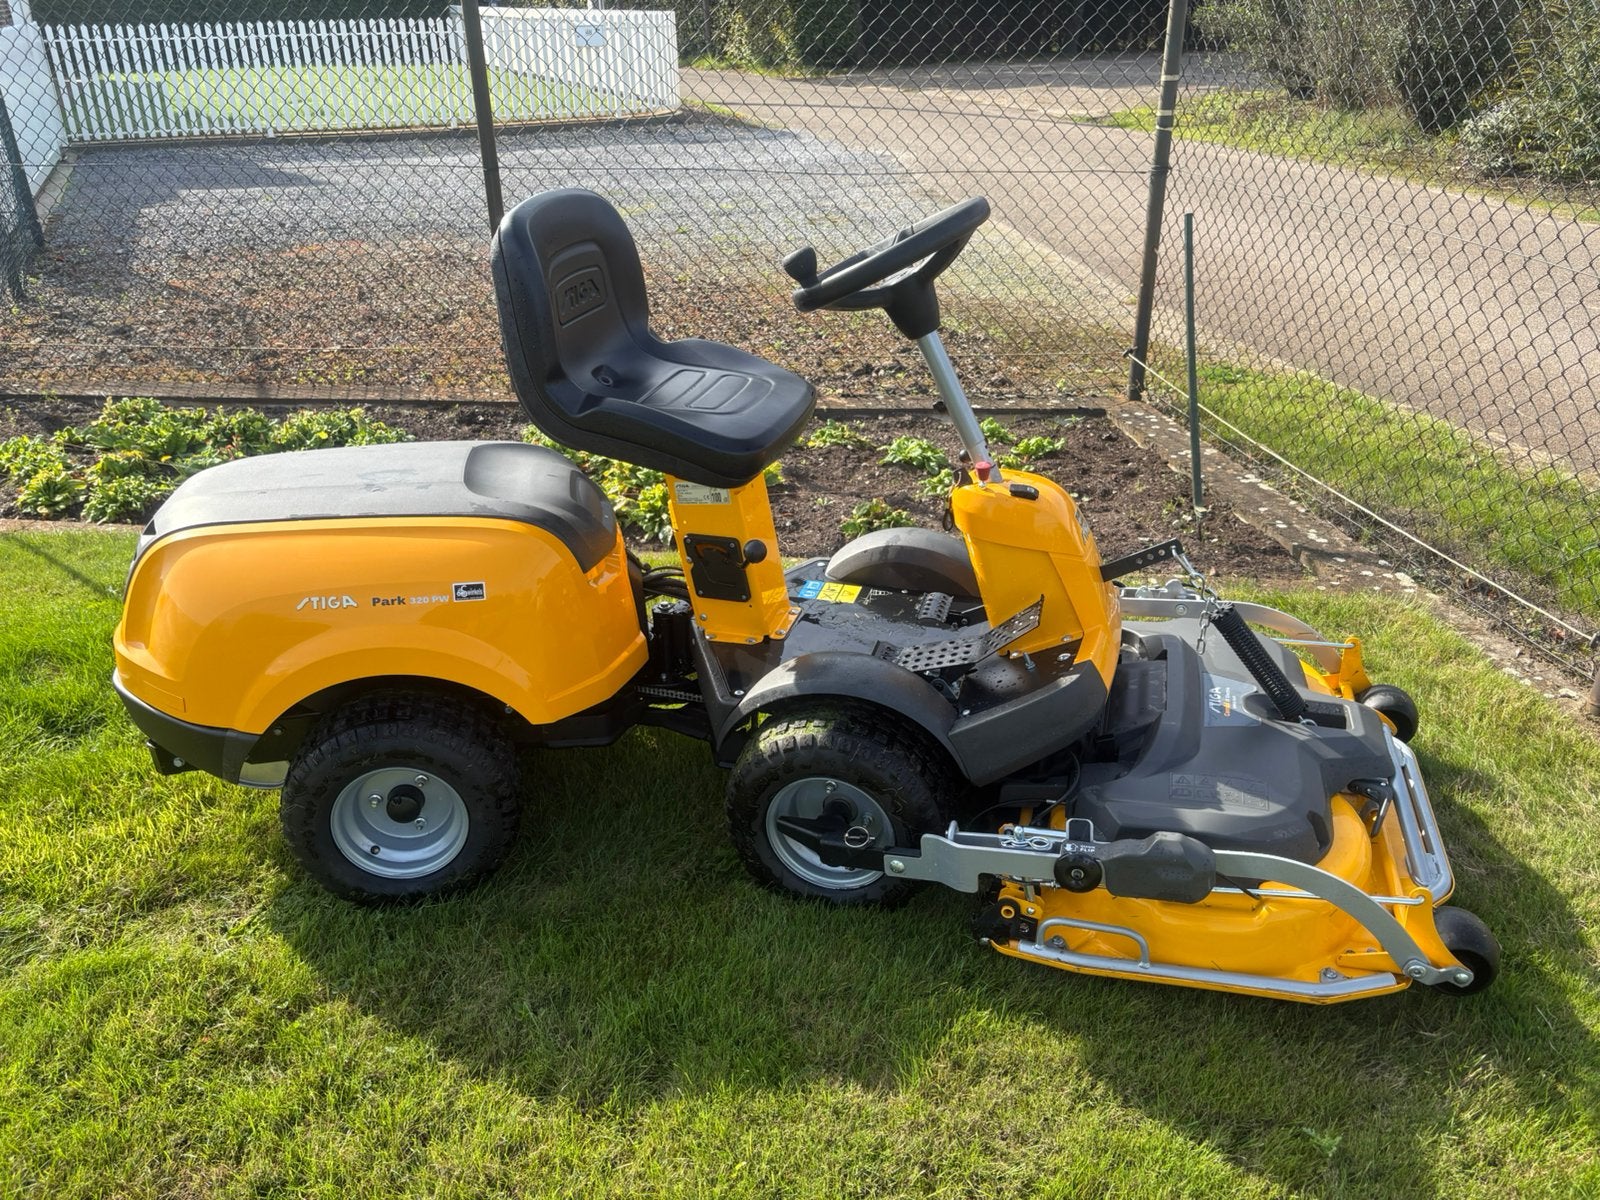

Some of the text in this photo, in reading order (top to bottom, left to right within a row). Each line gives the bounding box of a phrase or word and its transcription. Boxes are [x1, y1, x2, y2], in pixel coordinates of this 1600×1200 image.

[296, 595, 450, 610] STIGA Park 320 PW
[1208, 686, 1221, 713] STIGA
